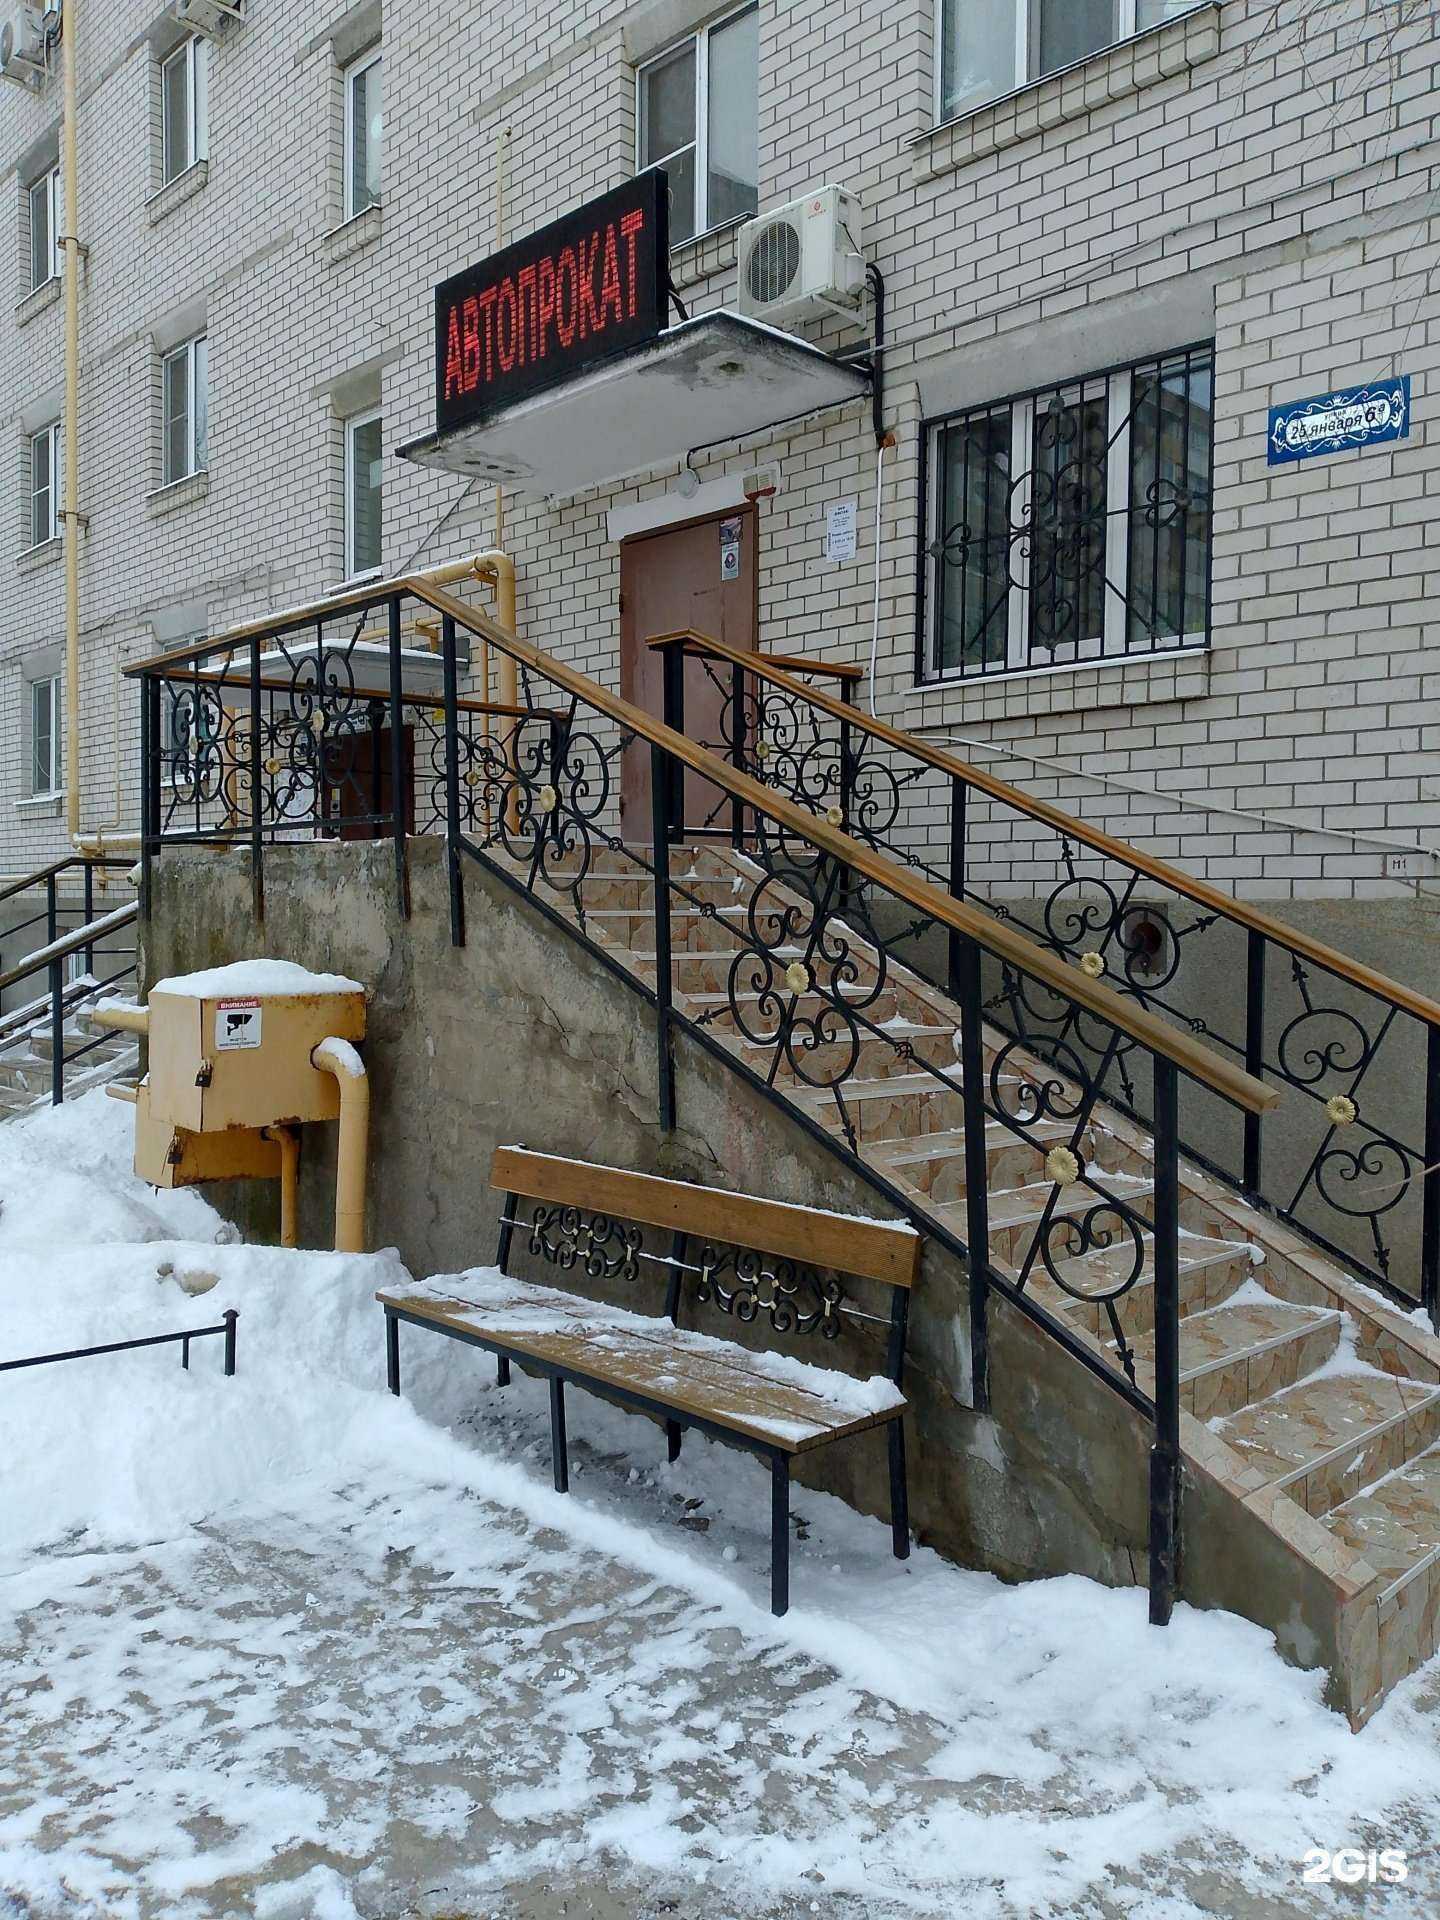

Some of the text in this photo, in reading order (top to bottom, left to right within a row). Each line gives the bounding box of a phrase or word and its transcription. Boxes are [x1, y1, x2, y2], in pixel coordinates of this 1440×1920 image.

[444, 208, 645, 400] АВТОПРОКАТ
[1290, 424, 1307, 440] 25
[1308, 414, 1362, 436] января
[220, 1000, 257, 1009] ВНИМАНИЕ
